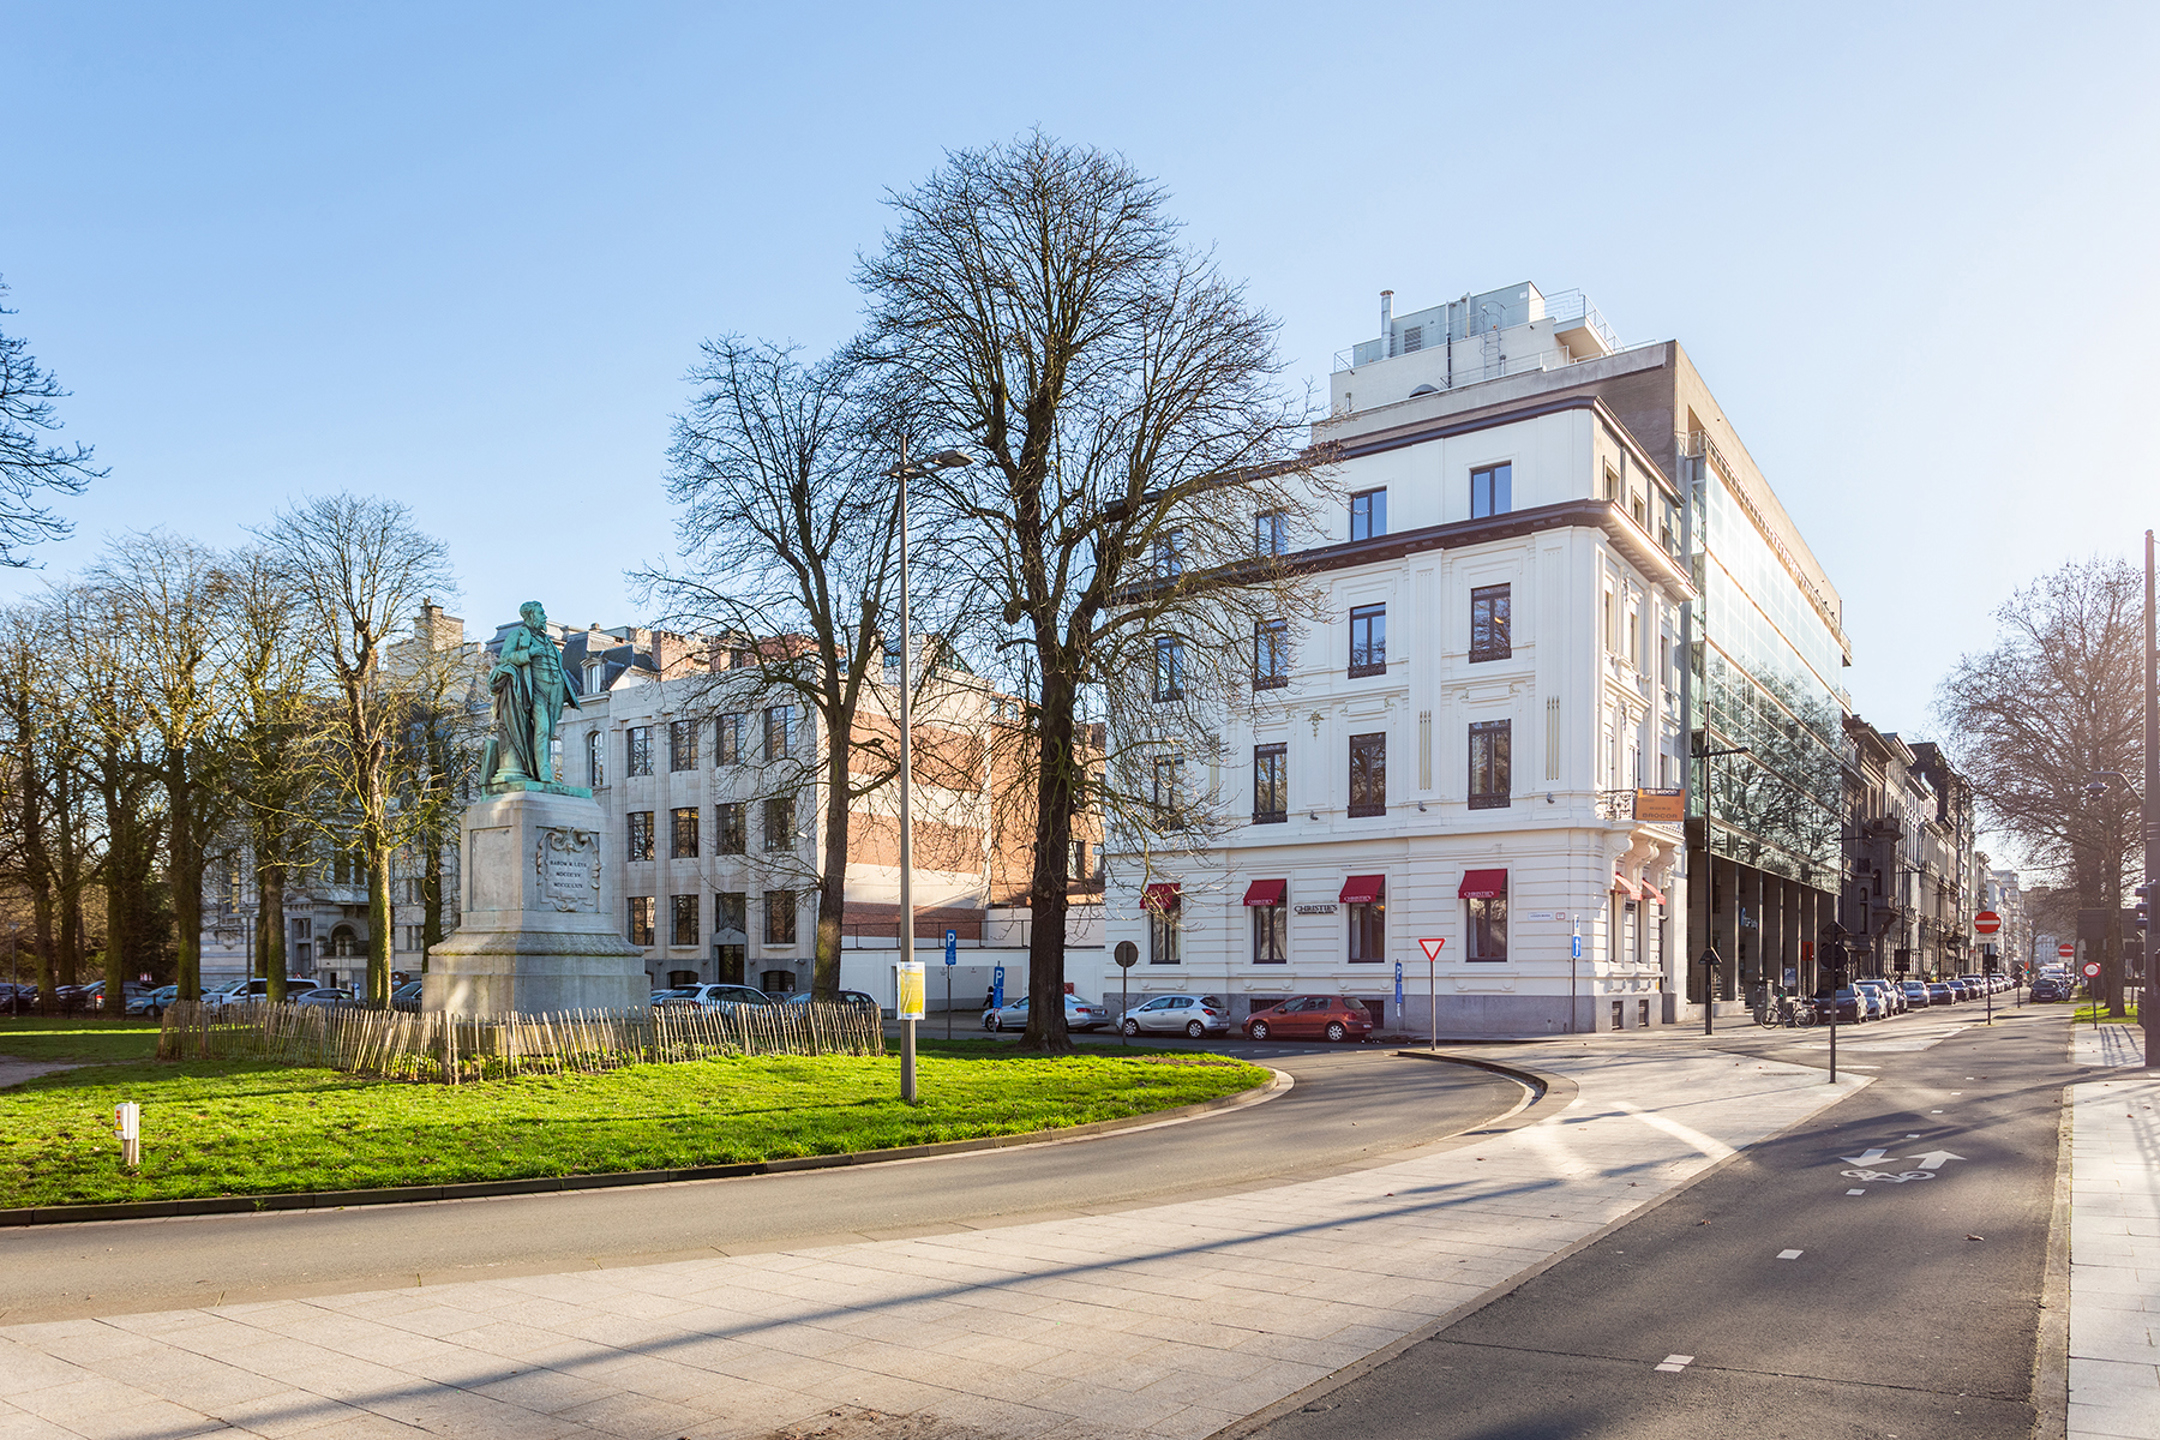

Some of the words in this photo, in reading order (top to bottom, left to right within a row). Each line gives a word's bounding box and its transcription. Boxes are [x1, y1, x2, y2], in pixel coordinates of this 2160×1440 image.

[1294, 904, 1338, 912] CHRISTIE'S
[947, 933, 955, 947] P
[995, 970, 1003, 984] P
